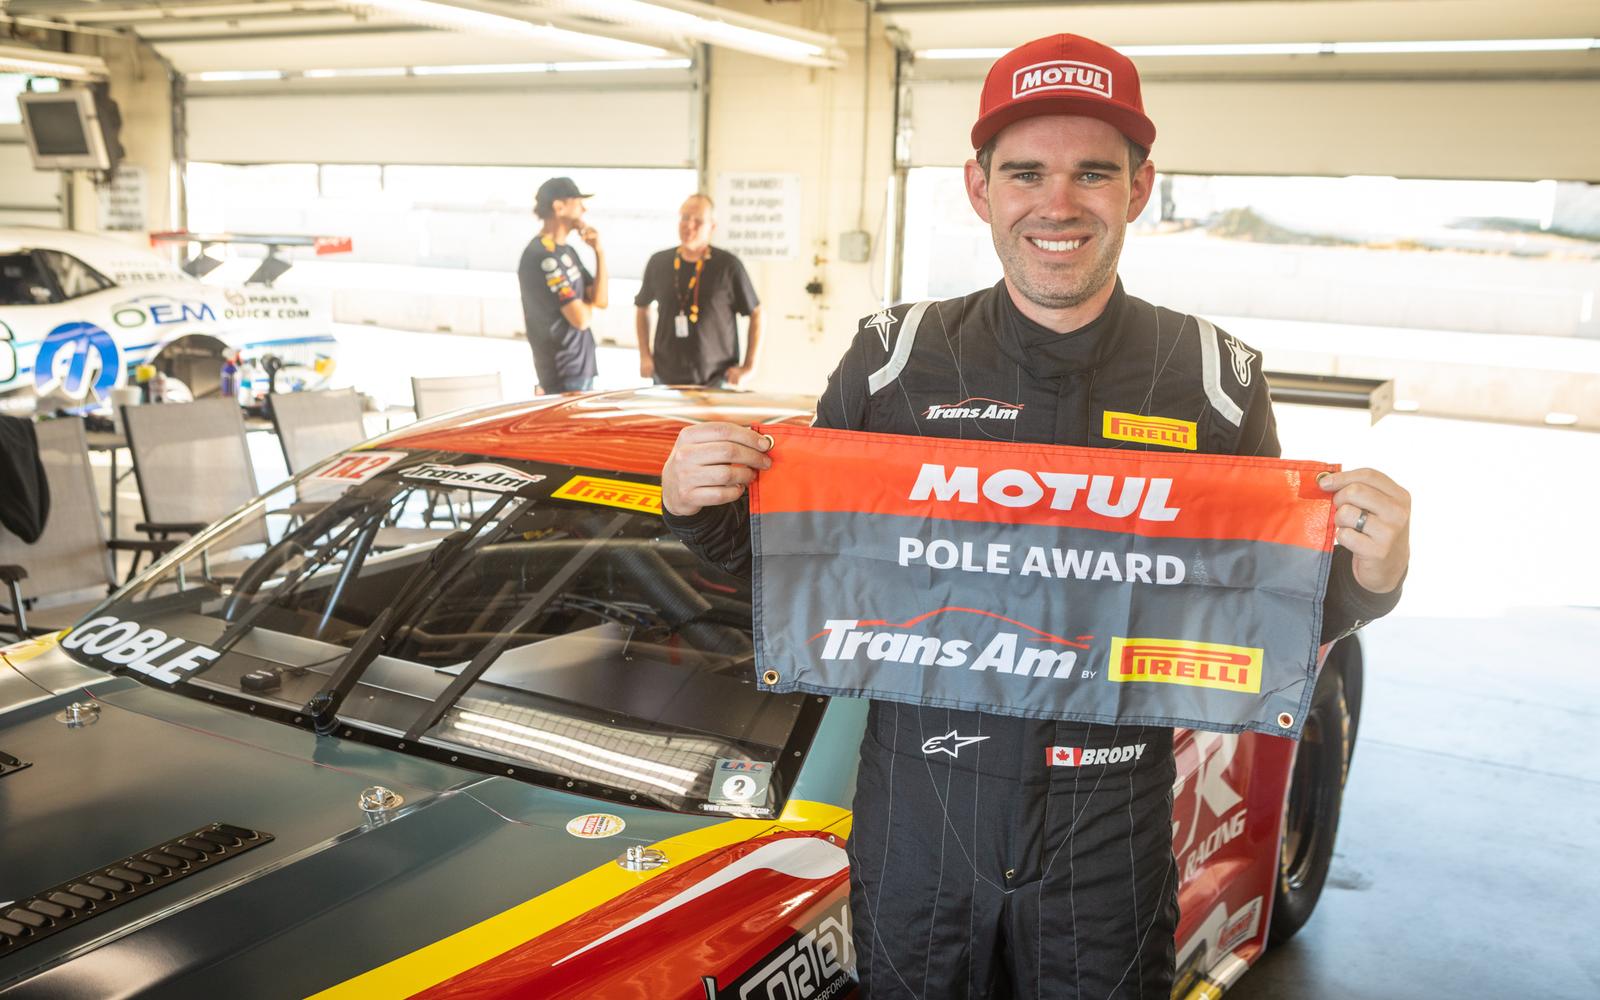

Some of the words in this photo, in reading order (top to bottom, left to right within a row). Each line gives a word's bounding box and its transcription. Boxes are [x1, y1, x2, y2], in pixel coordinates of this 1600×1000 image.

[1020, 67, 1105, 91] MOTUL
[113, 303, 216, 329] OEM
[926, 404, 981, 420] Trans
[979, 404, 1019, 420] Am
[1111, 417, 1189, 444] PIRELLI
[407, 465, 480, 482] Trans
[475, 472, 529, 488] Am
[909, 463, 1182, 522] MOTUL
[899, 537, 1011, 575] POLE
[1021, 546, 1187, 586] AWARD
[61, 616, 221, 684] GOBLE
[820, 619, 973, 667] Trans
[968, 632, 1078, 679] Am
[1081, 670, 1097, 679] BY
[1120, 645, 1252, 685] PIRELLI
[1078, 743, 1147, 766] BRODY
[733, 779, 746, 796] 2
[1183, 808, 1248, 884] RACING
